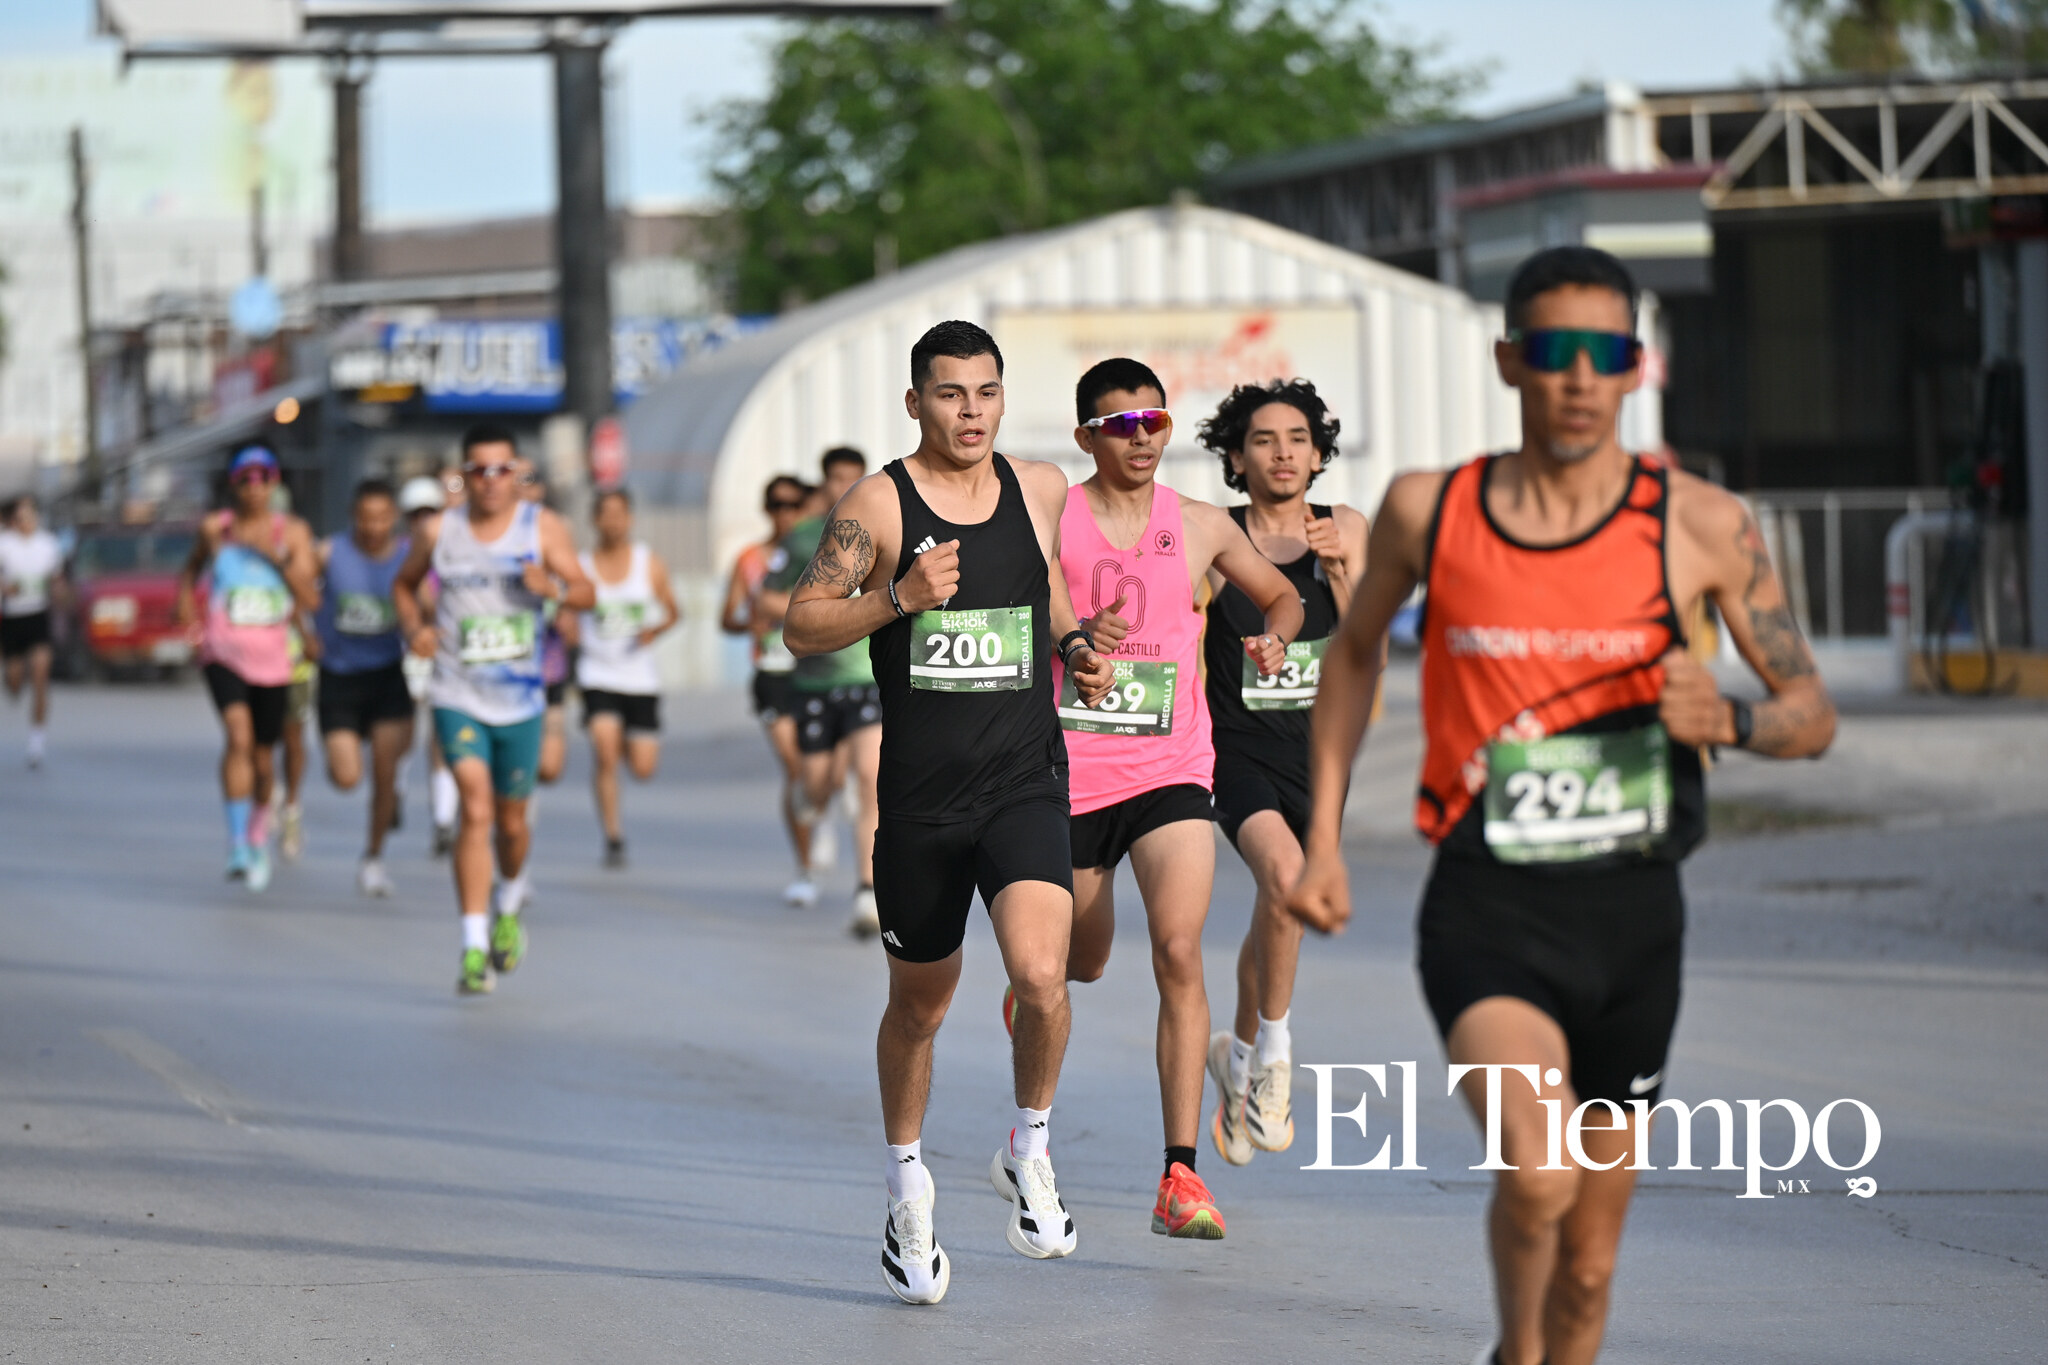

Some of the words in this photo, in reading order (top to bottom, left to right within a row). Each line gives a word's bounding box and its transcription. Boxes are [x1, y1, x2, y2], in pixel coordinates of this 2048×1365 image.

[941, 611, 988, 620] CARRERA
[1018, 612, 1030, 620] 200
[925, 632, 1002, 666] 200
[1021, 625, 1030, 679] MEDALLA
[1118, 642, 1160, 656] CASTILLO
[1072, 681, 1146, 712] 69
[1160, 679, 1173, 728] MEDALLA
[1505, 766, 1624, 821] 294
